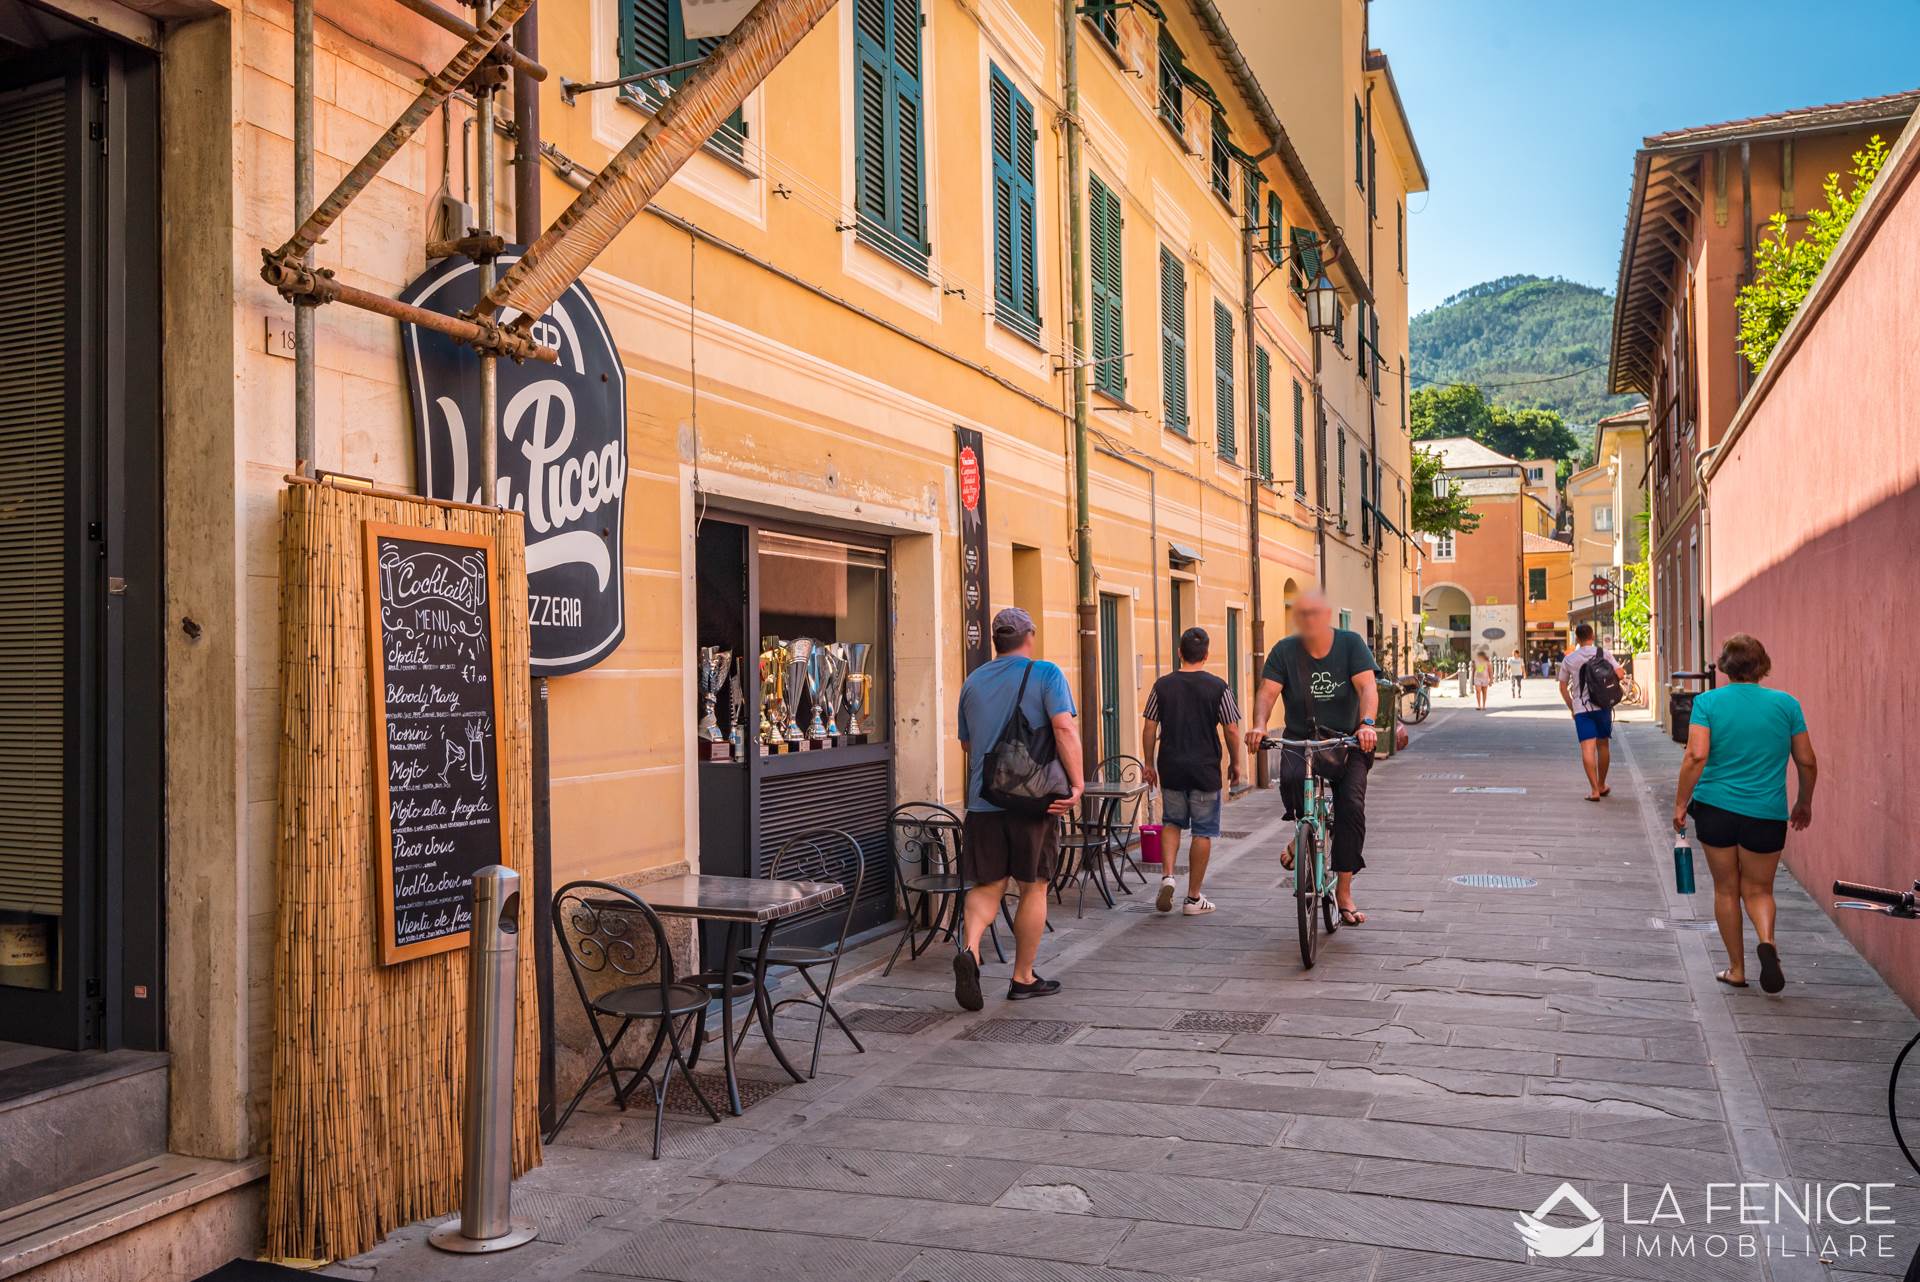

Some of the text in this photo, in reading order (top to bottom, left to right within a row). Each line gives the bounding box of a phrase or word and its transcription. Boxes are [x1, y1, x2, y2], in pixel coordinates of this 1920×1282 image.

[503, 379, 626, 533] Picea
[398, 562, 473, 608] Cocktails
[415, 609, 450, 631] MENU
[528, 595, 582, 627] ZZERIA
[1311, 671, 1332, 694] 25
[386, 684, 460, 712] Bloody Mary
[388, 723, 432, 741] Rossini
[422, 799, 447, 817] alla
[394, 834, 423, 859] Pisco
[434, 909, 450, 927] de
